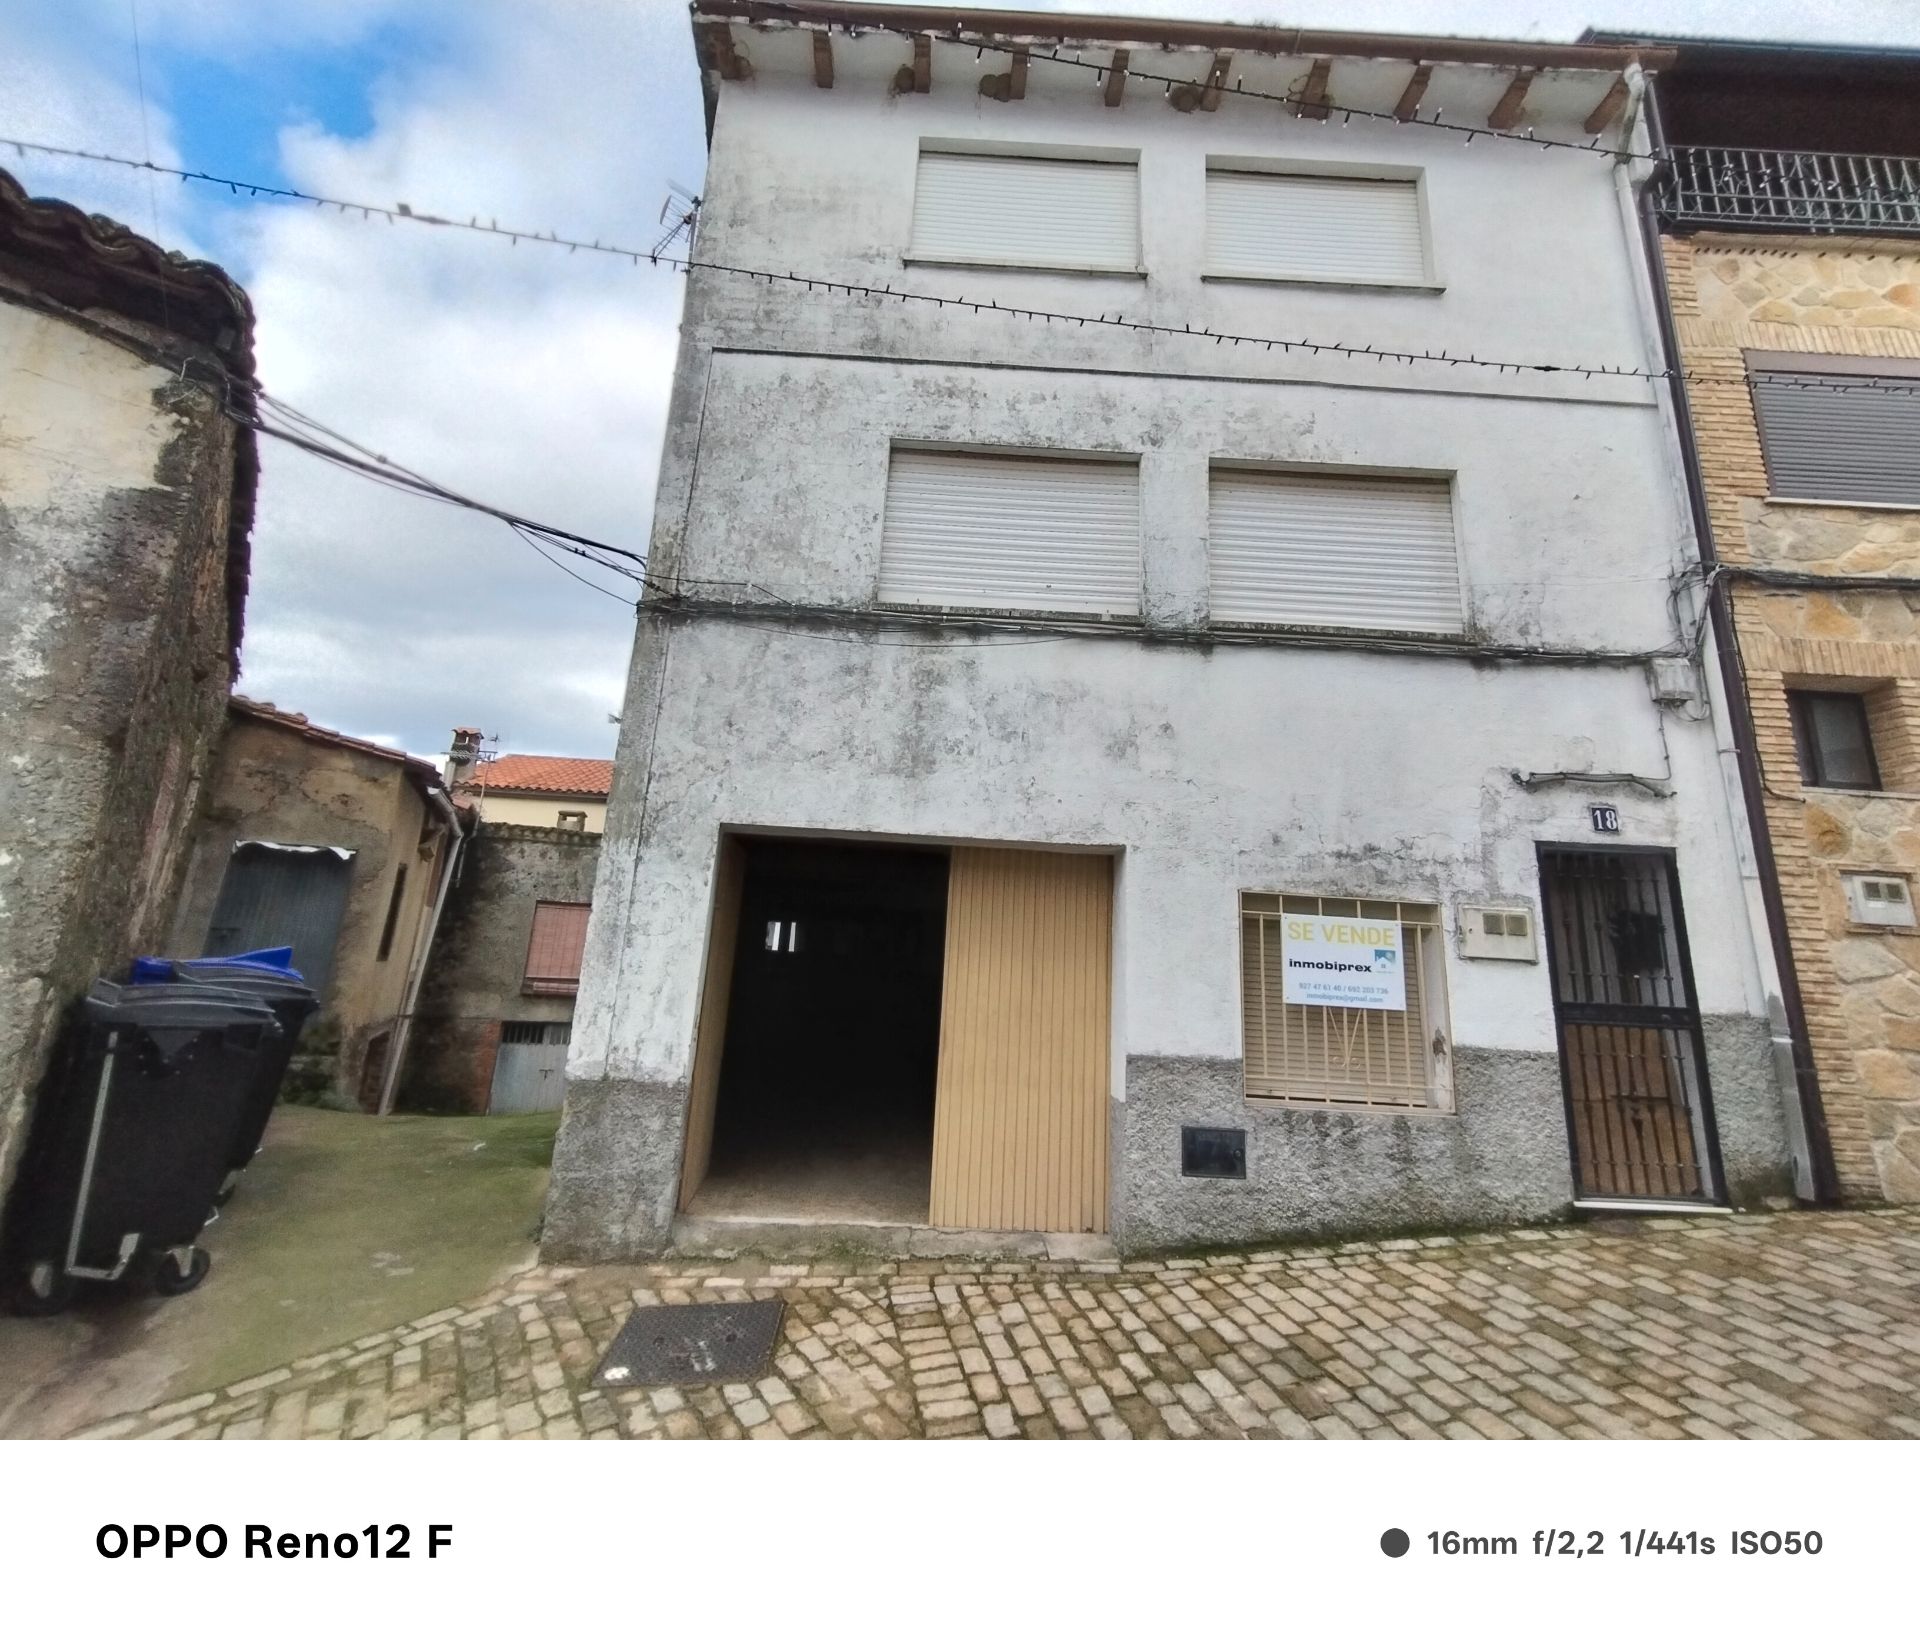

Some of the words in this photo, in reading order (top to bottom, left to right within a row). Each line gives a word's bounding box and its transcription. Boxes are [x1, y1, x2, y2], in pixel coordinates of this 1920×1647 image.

[1593, 810, 1617, 830] 18
[1288, 922, 1314, 941] SE
[1321, 924, 1396, 946] VENDE
[1289, 958, 1372, 973] inmobiprex
